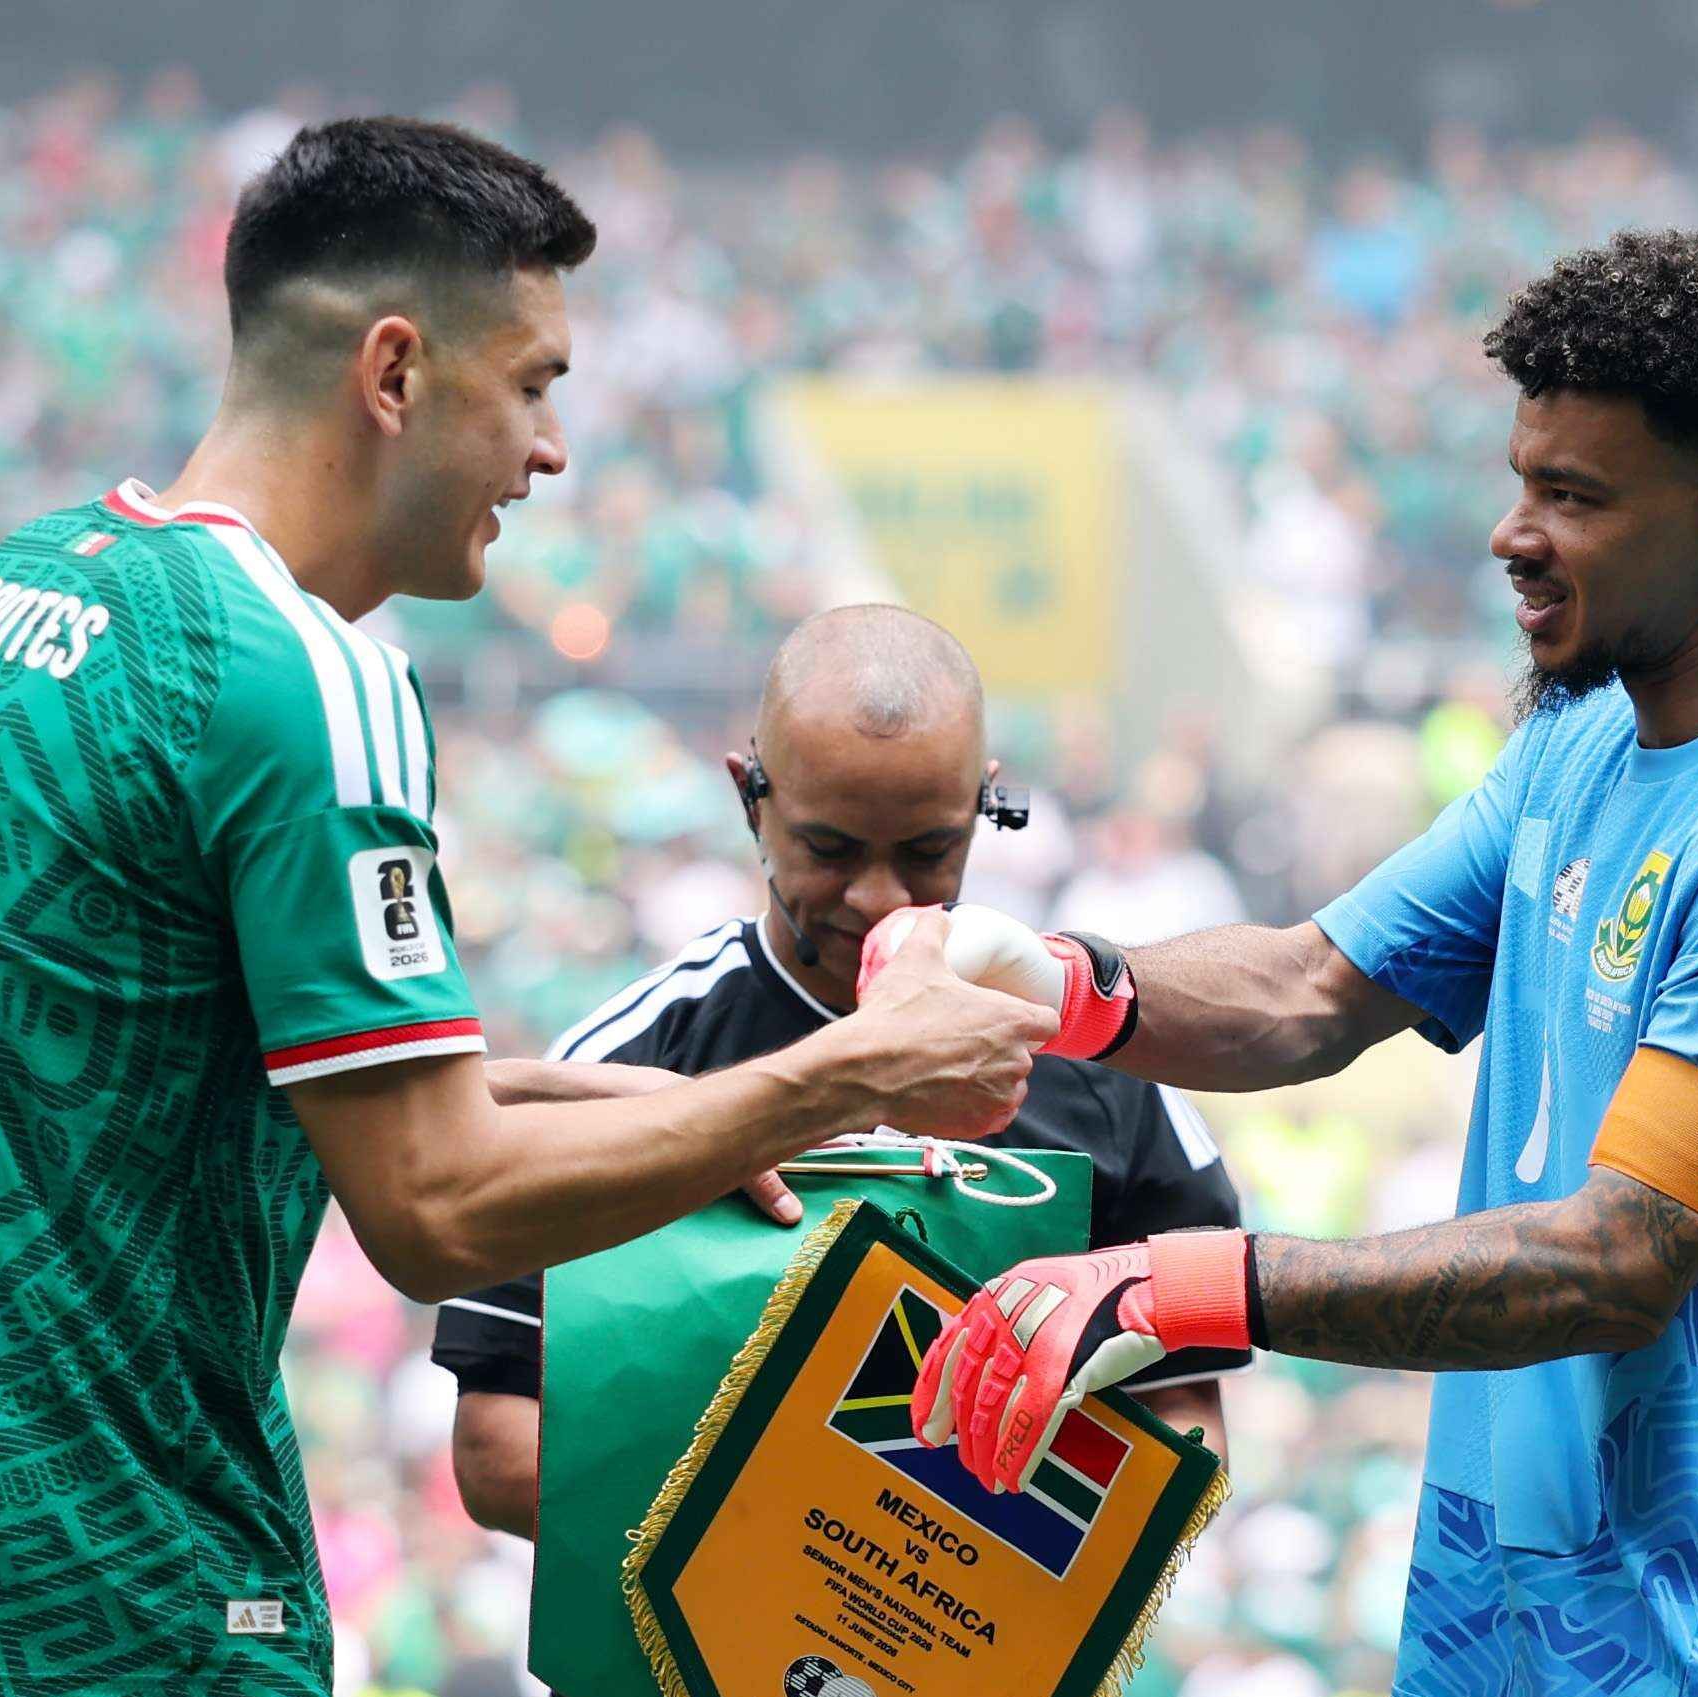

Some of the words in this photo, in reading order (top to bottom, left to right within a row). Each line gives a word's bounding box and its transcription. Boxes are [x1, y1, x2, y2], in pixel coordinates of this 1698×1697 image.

[875, 1487, 979, 1567] MEXICO
[803, 1544, 847, 1578] SENIOR
[882, 1594, 937, 1638] NATIONAL
[940, 1630, 972, 1659] TEAM
[804, 1508, 900, 1578] SOUTH
[897, 1570, 996, 1646] AFRICA
[824, 1577, 848, 1598] FIFA
[847, 1591, 887, 1621] WORLD
[887, 1617, 910, 1634] CUP
[908, 1631, 933, 1652] 2026
[794, 1613, 828, 1638] ESTADIO
[867, 1659, 898, 1683] MEXICO
[896, 1679, 916, 1694] CITY
[836, 1613, 849, 1625] 11
[847, 1621, 877, 1644] JUNE
[874, 1639, 899, 1658] 2026
